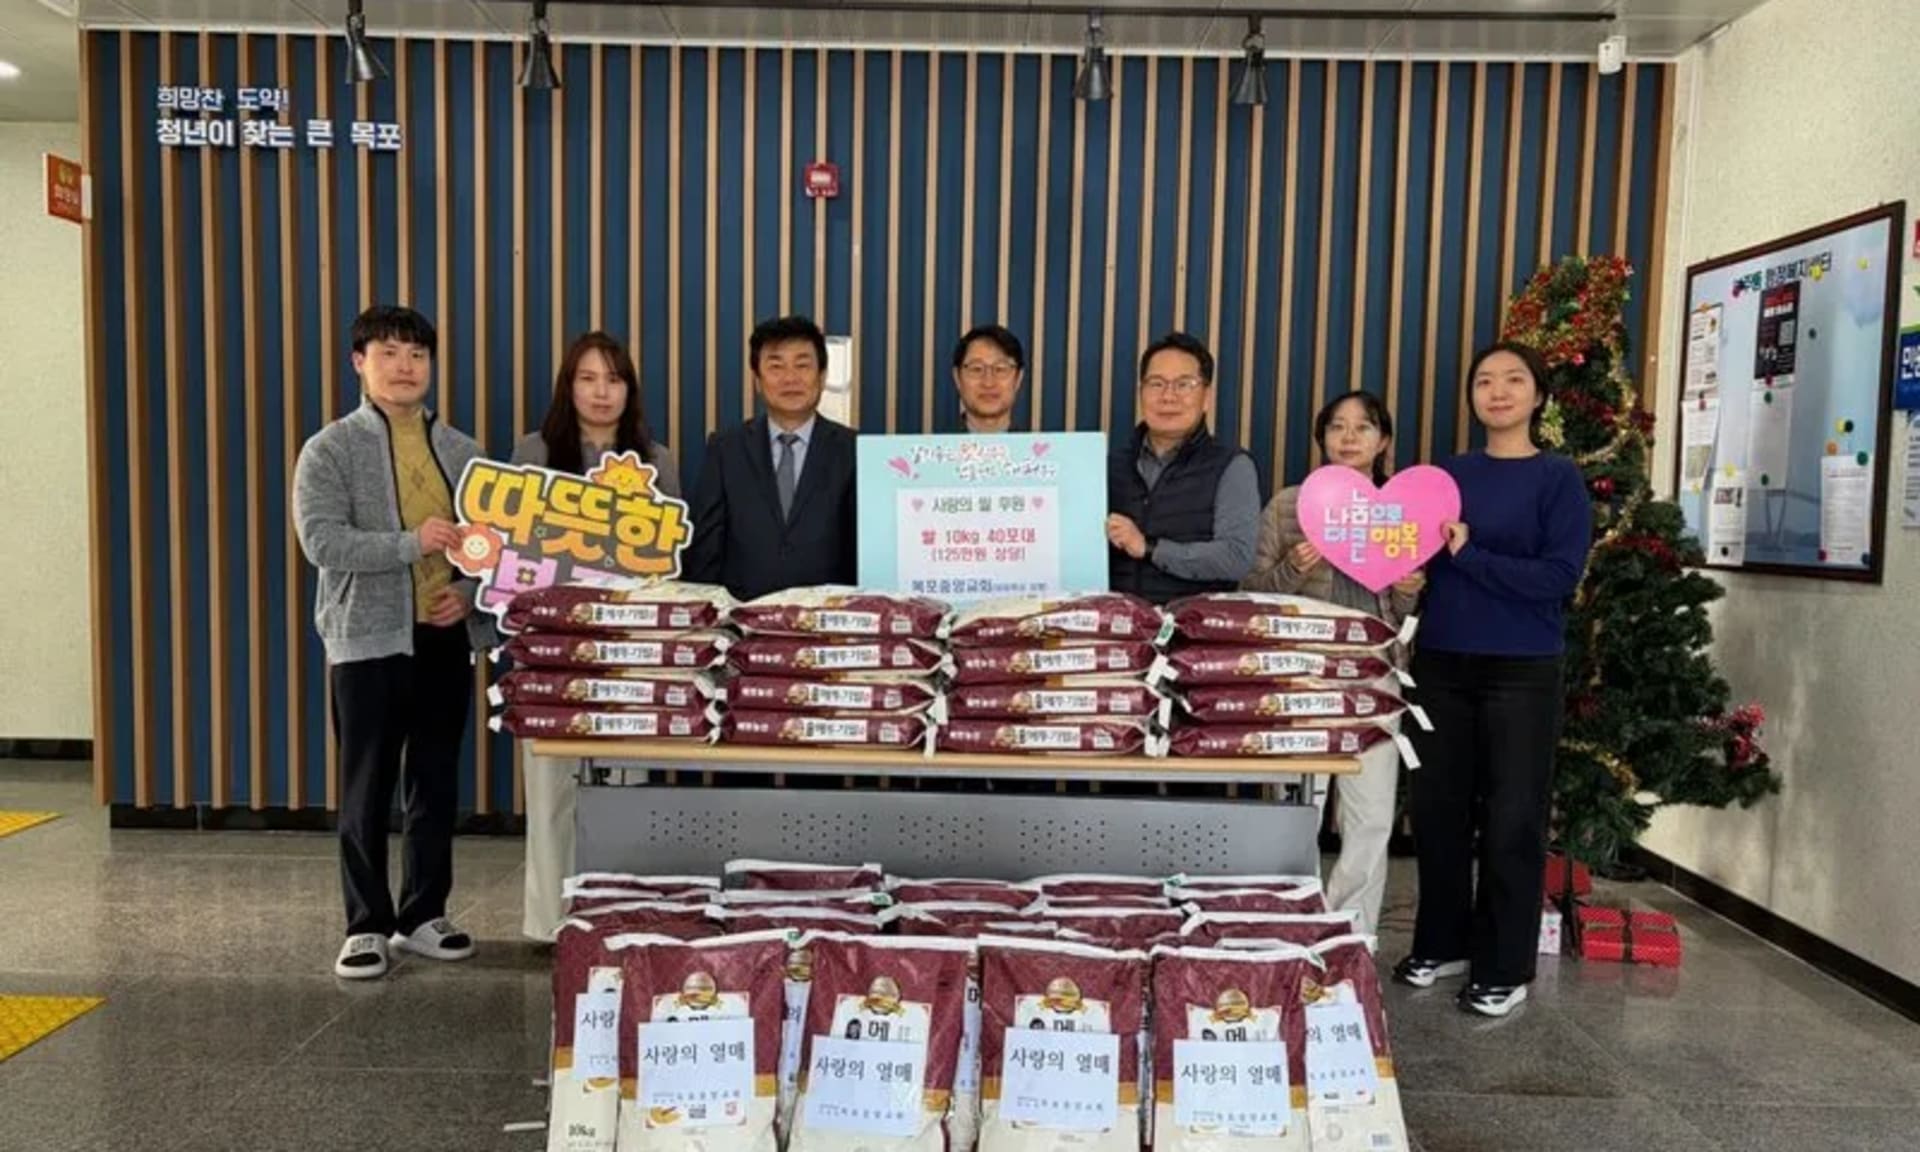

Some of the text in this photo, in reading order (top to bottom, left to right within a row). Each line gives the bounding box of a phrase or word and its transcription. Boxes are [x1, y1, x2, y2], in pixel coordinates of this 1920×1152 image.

[158, 86, 289, 111] 희망찬 도약!
[157, 119, 402, 150] 청년이 찾는 큰 목포
[932, 496, 1025, 513] 사랑의 쌀 후원
[463, 465, 687, 572] 따뜻한
[922, 528, 1036, 545] 쌀 10kg 40포대
[1370, 522, 1418, 560] 행복
[932, 547, 1025, 562] (125만원 상당)
[581, 1010, 615, 1030] 사랑
[1331, 1022, 1362, 1043] 열매
[643, 1041, 745, 1066] 사랑의 열매
[1009, 1047, 1110, 1075] 사랑의 열매
[815, 1055, 913, 1083] 사랑의 열매
[1181, 1063, 1282, 1086] 사랑의 열매
